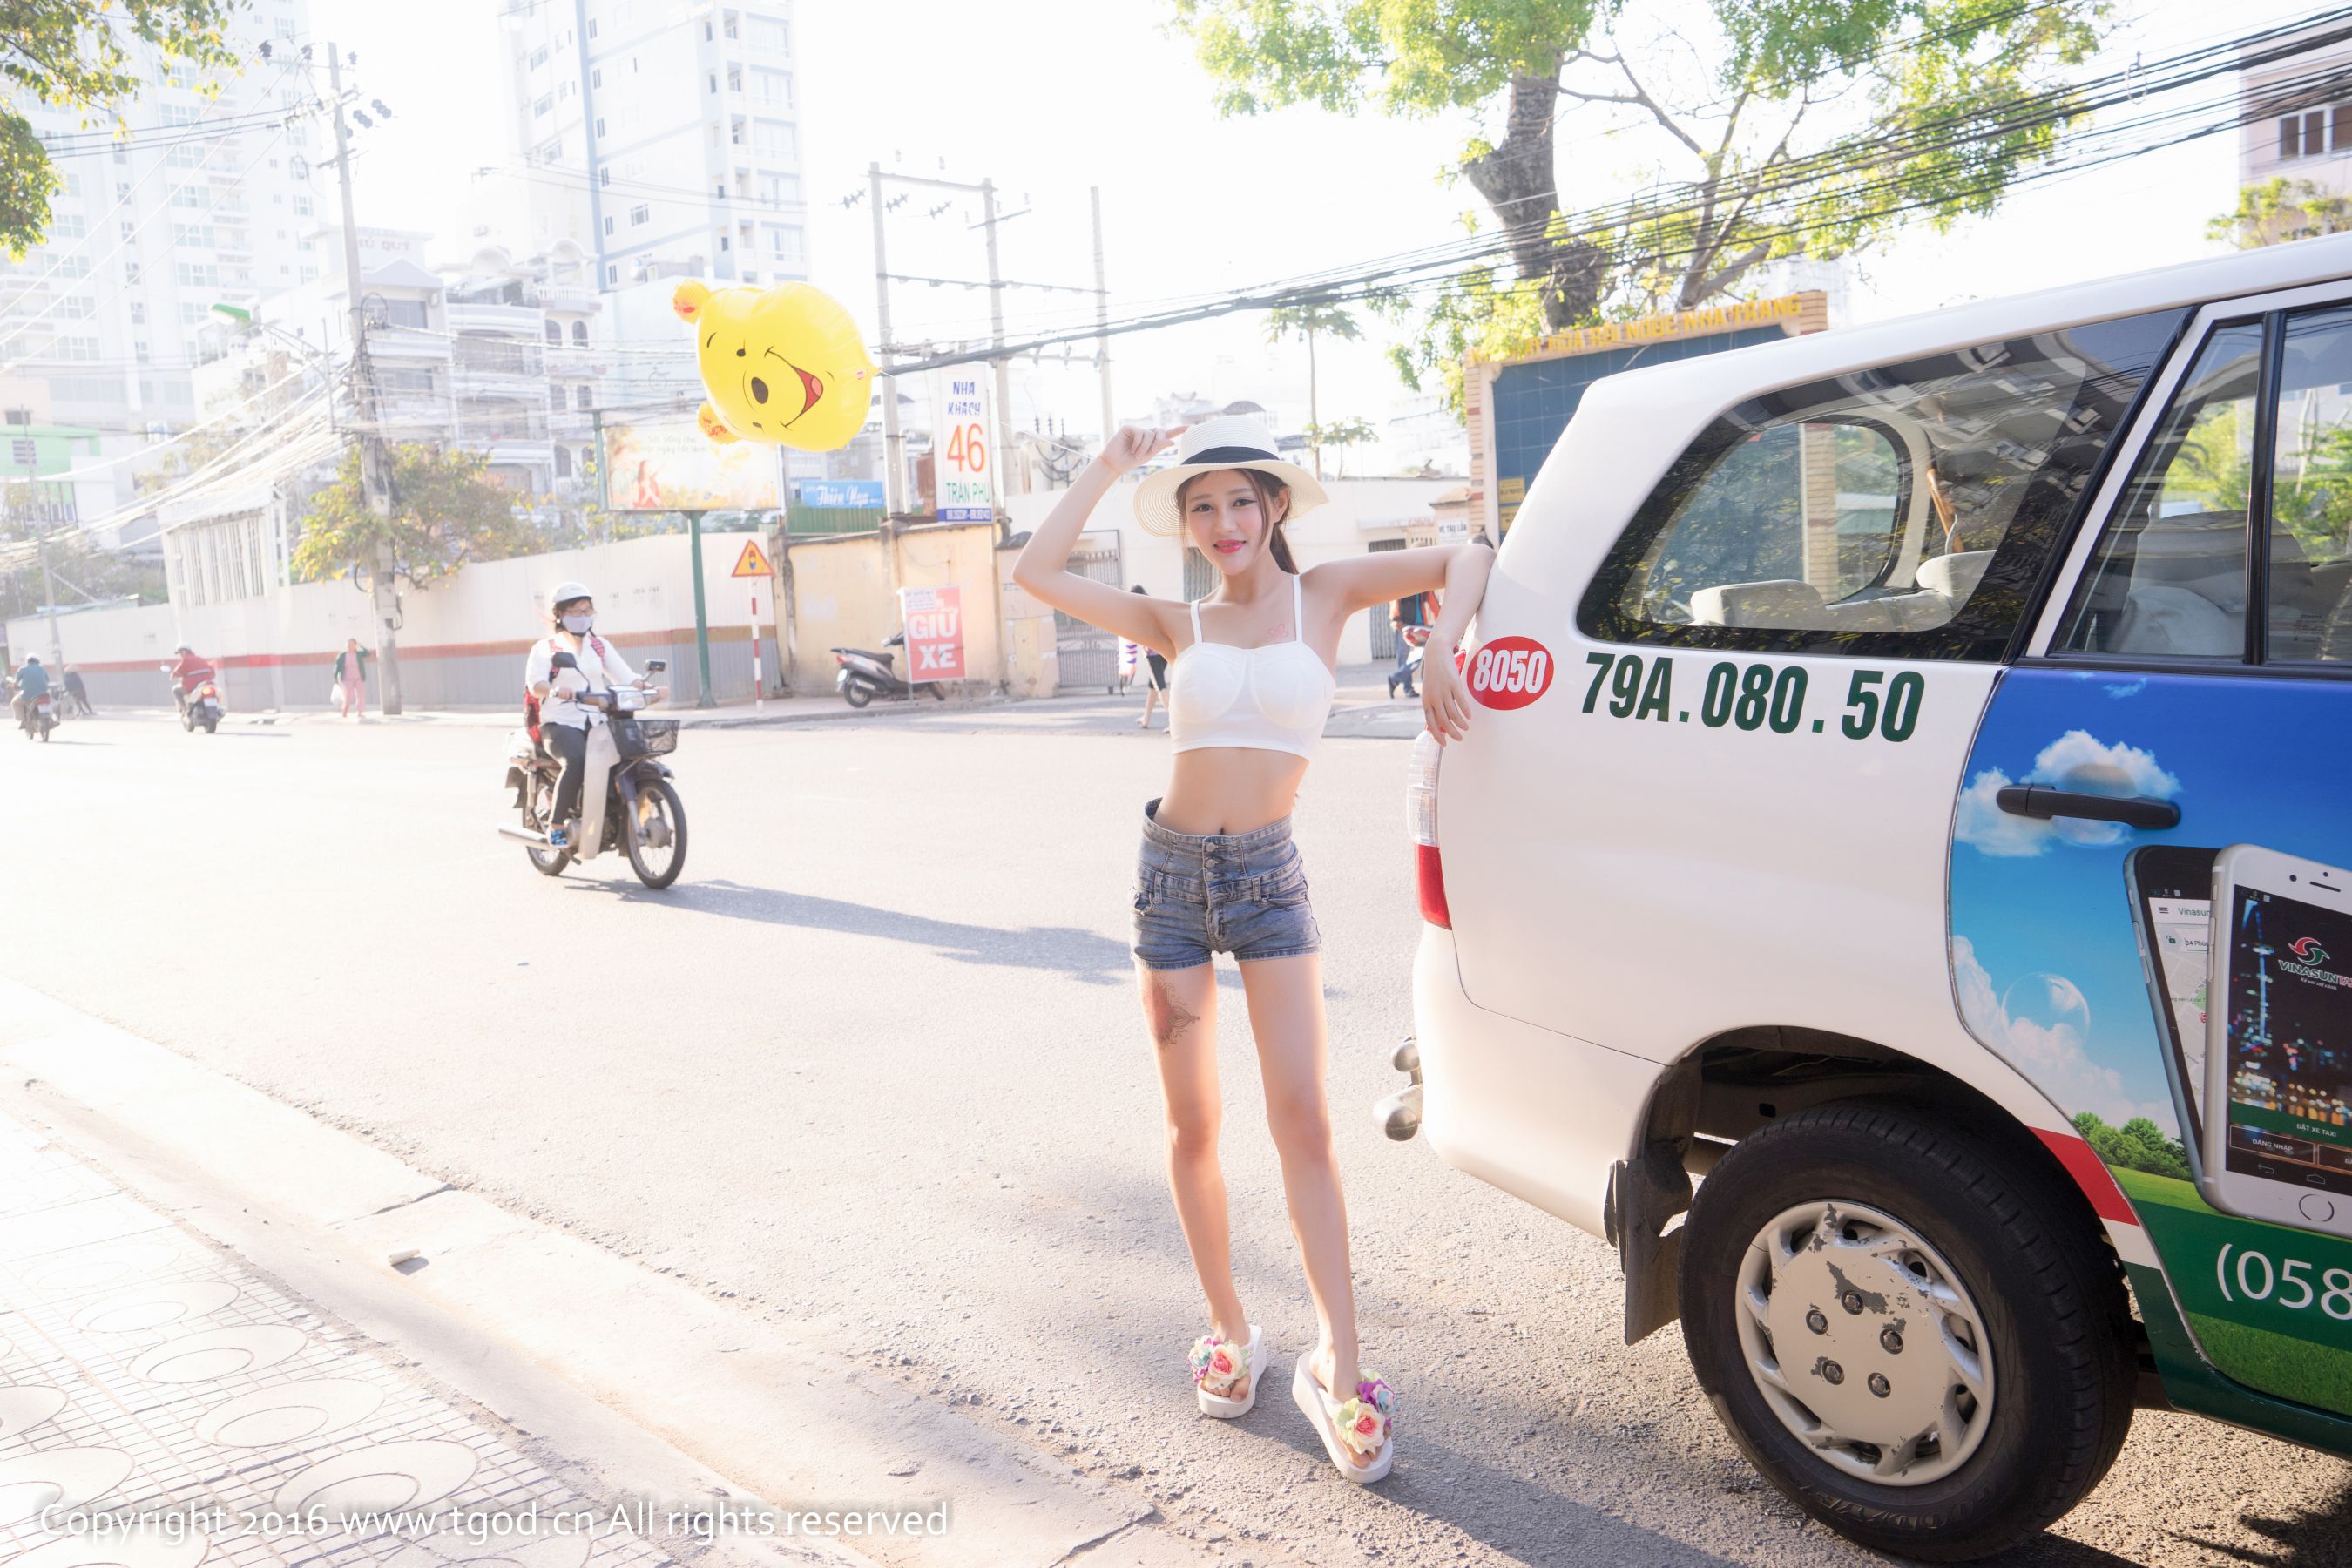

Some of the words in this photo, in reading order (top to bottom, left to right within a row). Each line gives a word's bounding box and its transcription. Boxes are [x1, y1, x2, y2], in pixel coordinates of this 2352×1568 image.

[1733, 294, 1800, 324] TRANG
[947, 423, 986, 472] 46
[919, 643, 957, 670] XE
[1473, 649, 1548, 693] 8050
[2217, 1243, 2352, 1321] (058
